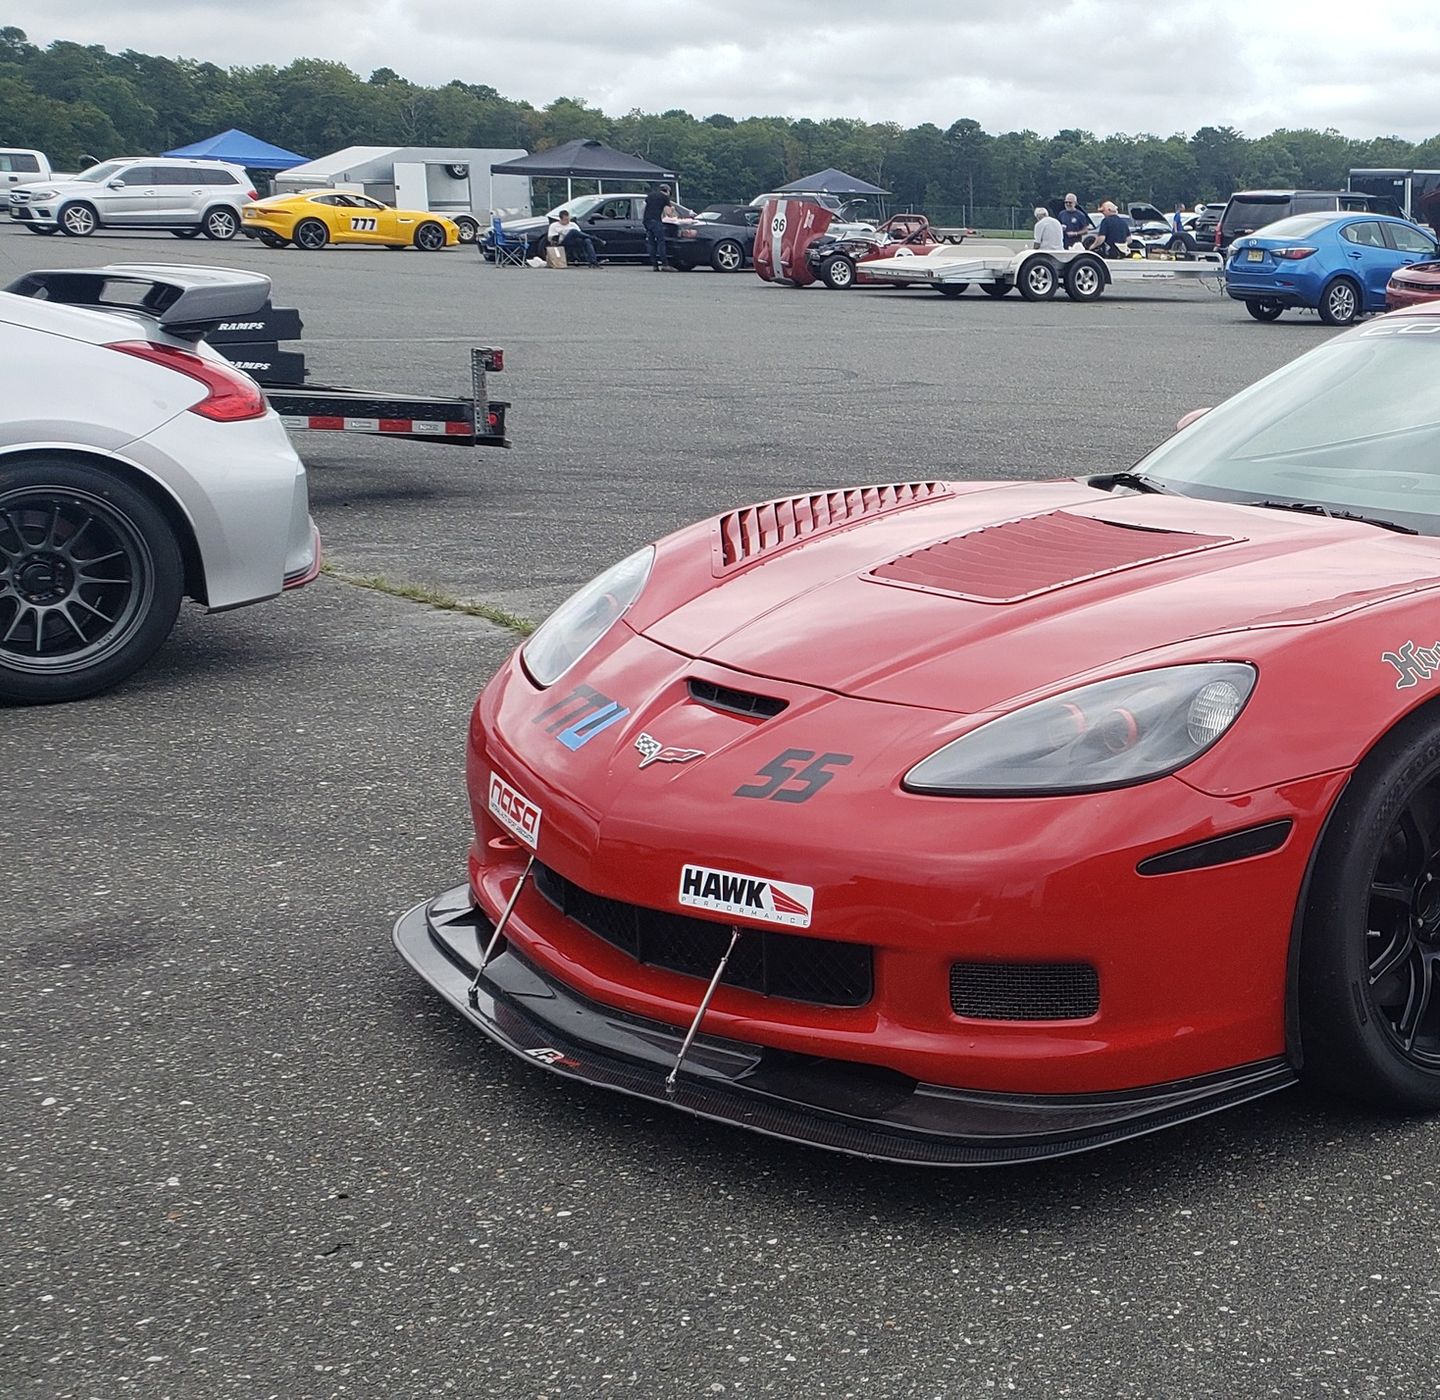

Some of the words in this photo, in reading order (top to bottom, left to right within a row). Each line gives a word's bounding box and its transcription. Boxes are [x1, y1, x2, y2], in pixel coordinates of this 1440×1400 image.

[352, 217, 376, 230] 777
[773, 218, 785, 232] 36
[218, 322, 265, 330] RAMPS
[531, 682, 631, 752] TTU
[732, 748, 855, 804] 55
[491, 778, 538, 834] nasa
[682, 868, 768, 909] HAWK
[681, 897, 809, 926] PERFORMANCE
